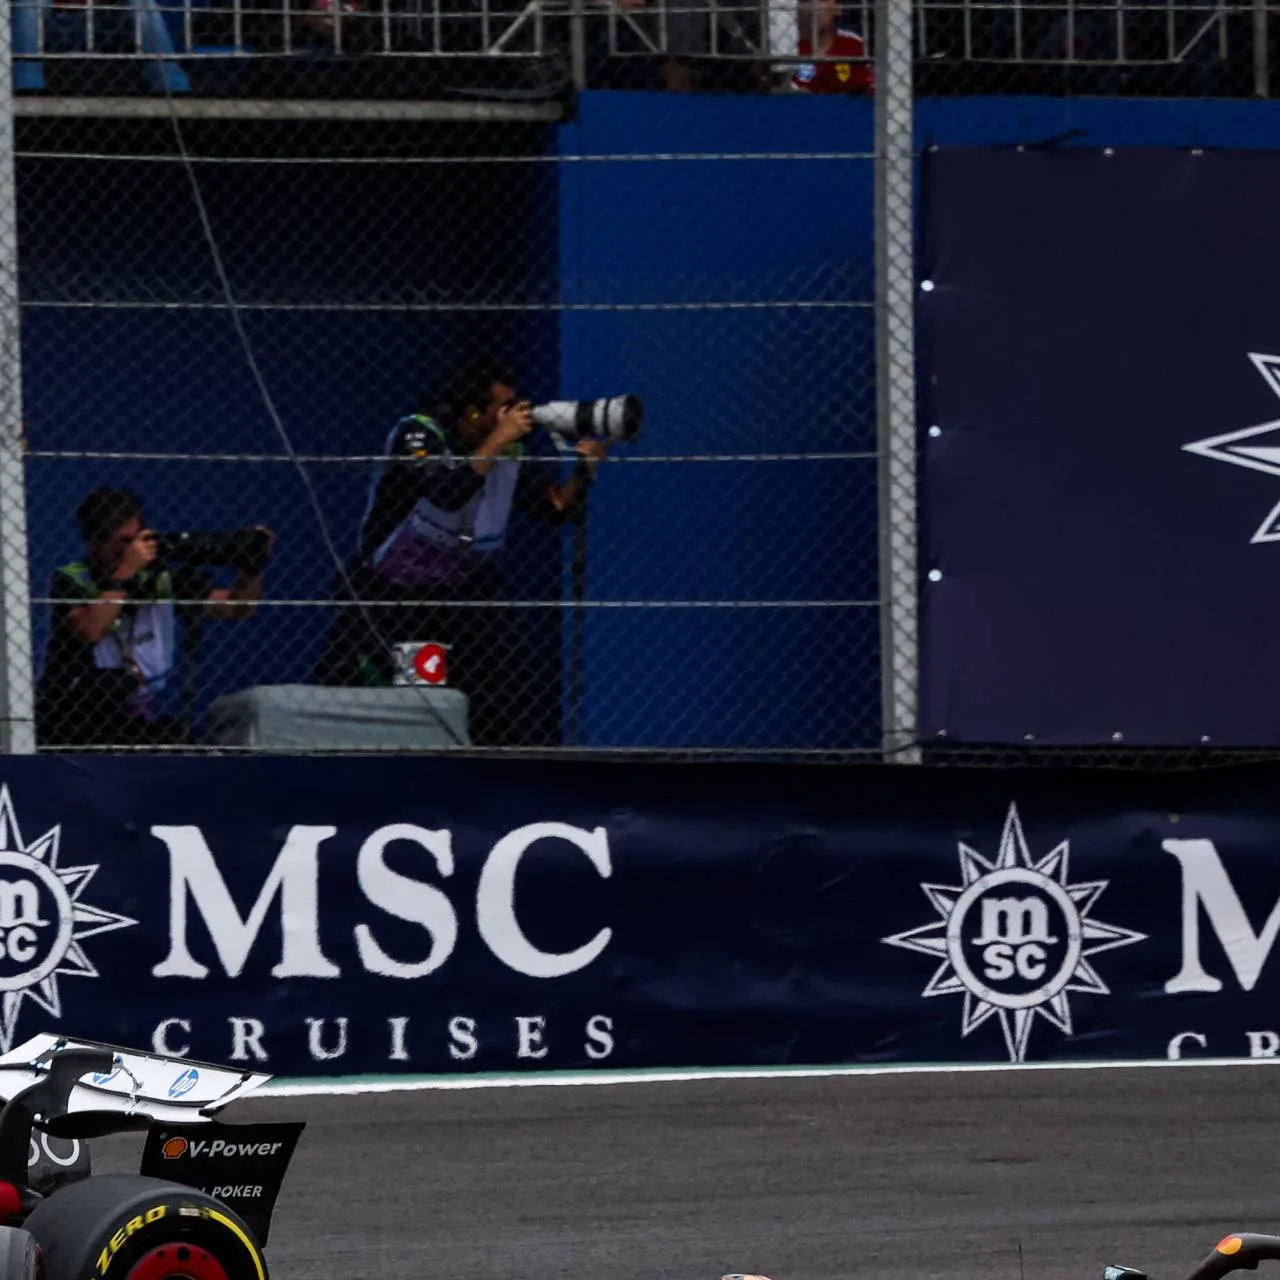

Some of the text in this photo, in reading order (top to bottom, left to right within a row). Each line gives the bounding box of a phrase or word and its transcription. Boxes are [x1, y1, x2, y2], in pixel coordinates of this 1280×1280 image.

[151, 822, 613, 978] MSC
[153, 1016, 615, 1061] CRUISES
[189, 1140, 282, 1159] V-Power
[211, 1186, 263, 1198] POKER
[96, 1205, 168, 1276] ZERO
